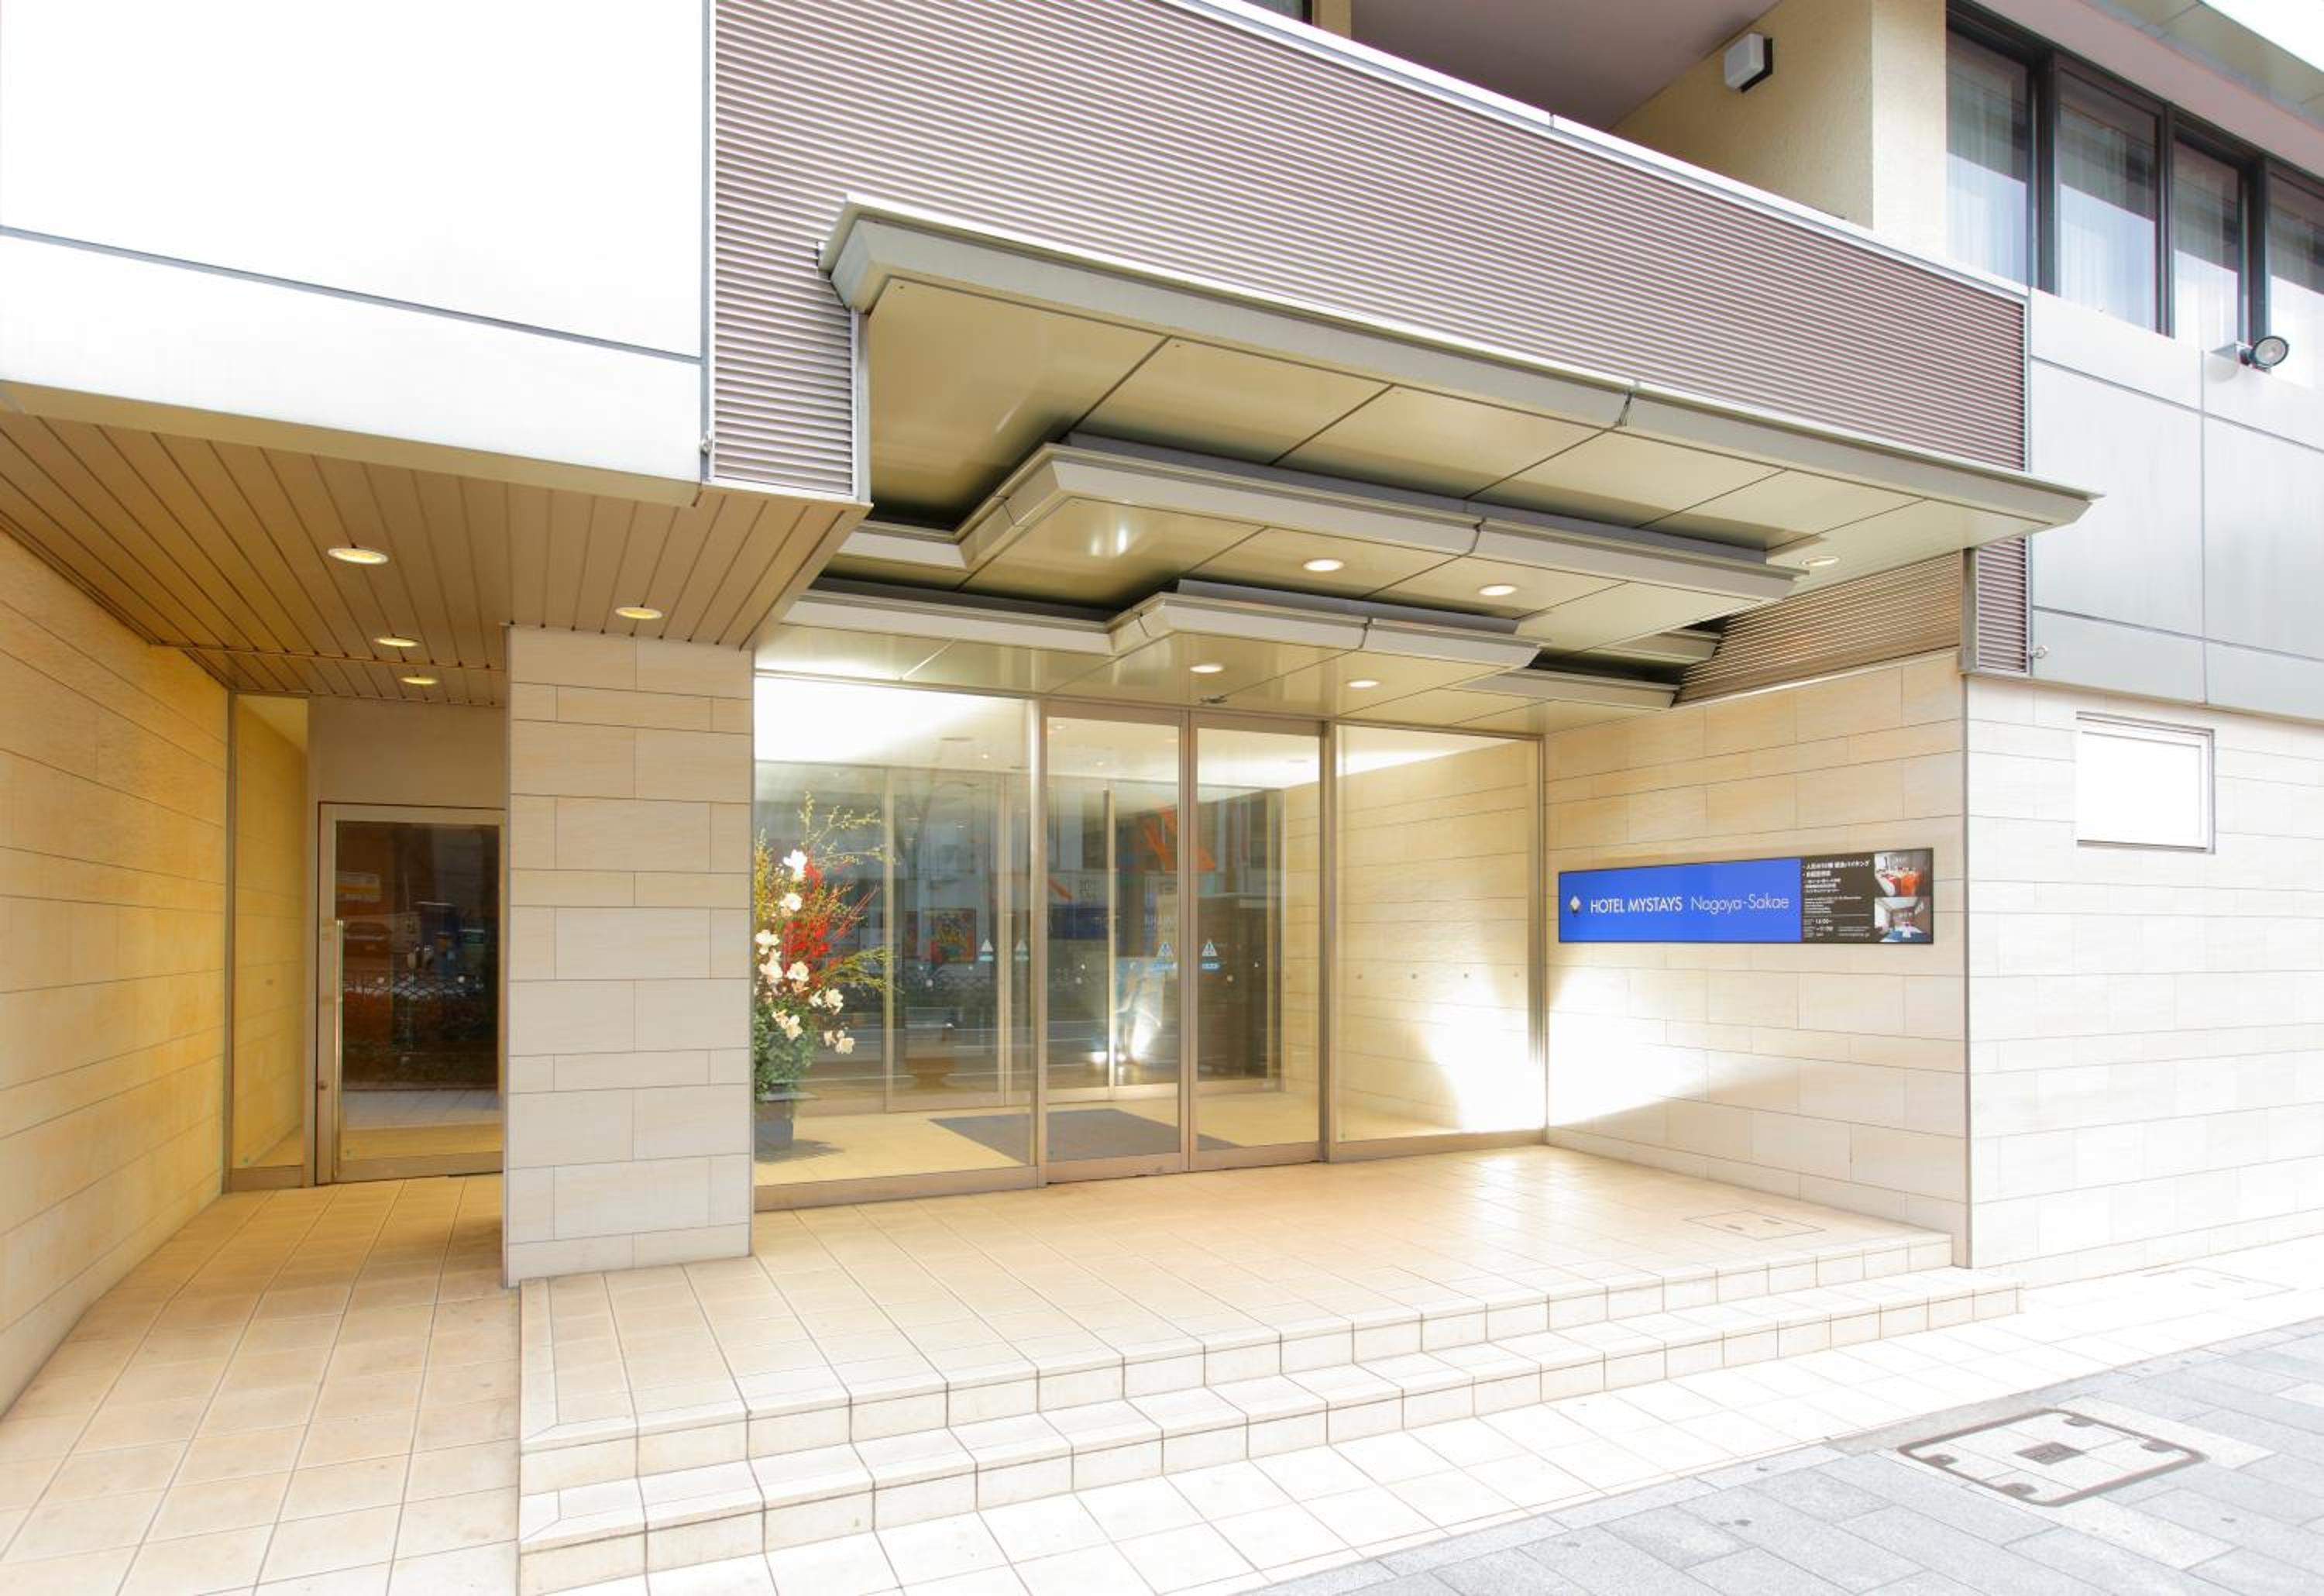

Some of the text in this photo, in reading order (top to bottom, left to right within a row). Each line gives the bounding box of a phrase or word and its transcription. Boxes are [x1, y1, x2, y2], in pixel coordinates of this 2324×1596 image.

[1590, 893, 1790, 915] HOTEL MYSTAYS Nagoya-Sakae
